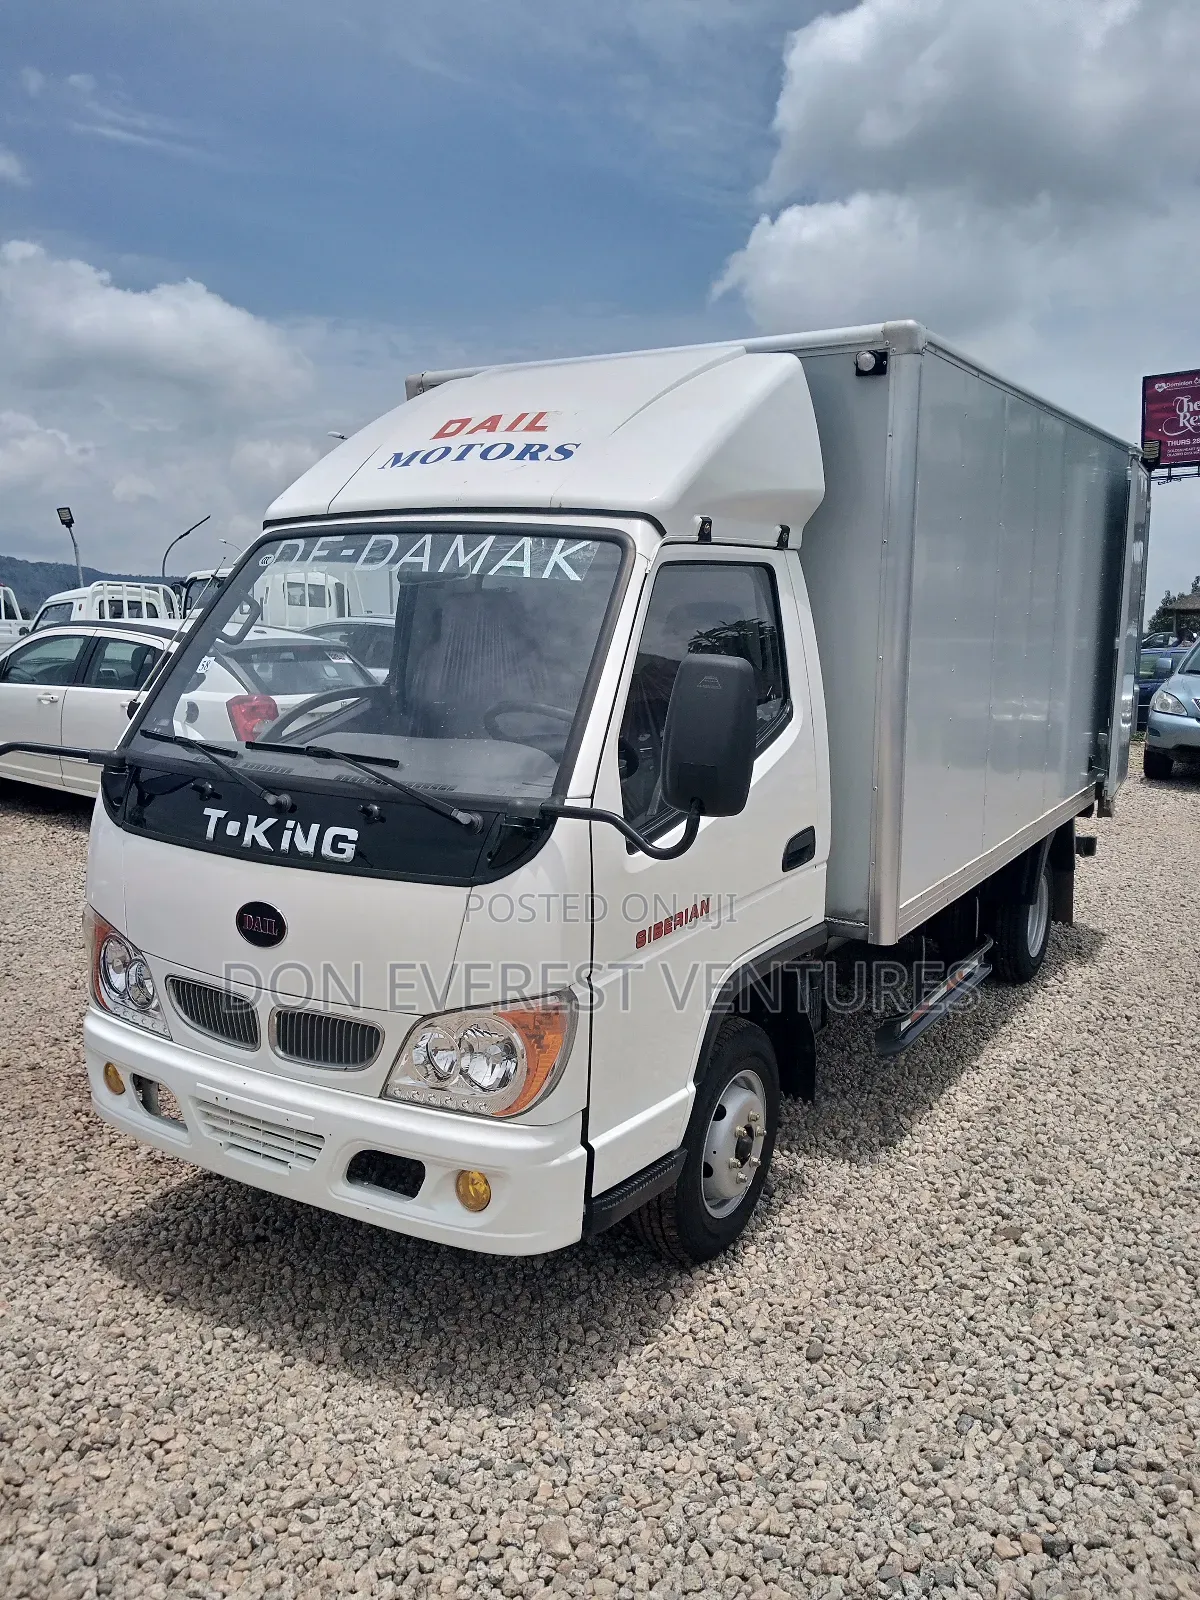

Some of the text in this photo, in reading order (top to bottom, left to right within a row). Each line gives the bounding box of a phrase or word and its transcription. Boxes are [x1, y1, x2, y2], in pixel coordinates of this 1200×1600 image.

[429, 412, 548, 441] DAIL
[1167, 438, 1191, 447] THURS
[377, 443, 581, 470] MOTORS
[242, 914, 278, 936] DAIL
[635, 897, 710, 949] SIBERIAN
